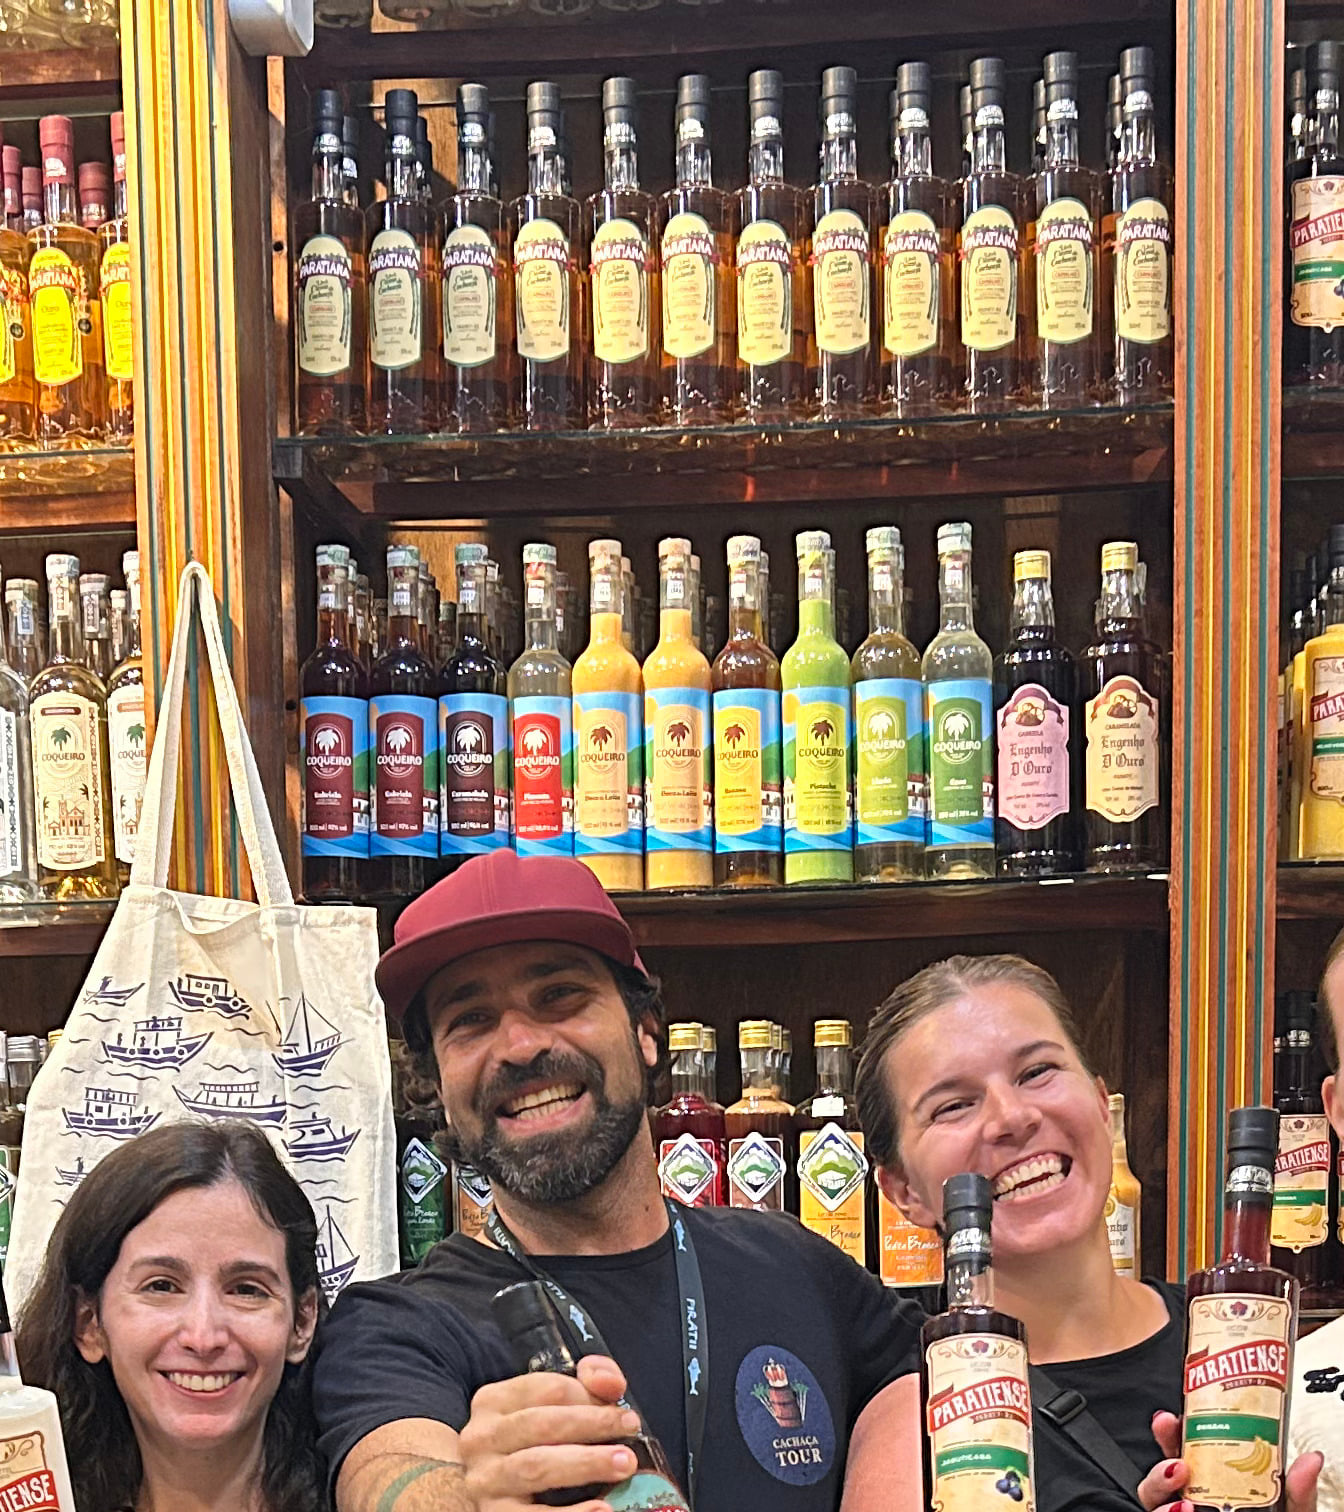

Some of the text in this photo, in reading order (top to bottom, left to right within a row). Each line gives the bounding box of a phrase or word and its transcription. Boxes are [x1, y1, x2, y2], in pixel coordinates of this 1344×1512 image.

[815, 238, 867, 255] PARATIANA
[886, 237, 939, 255] PARATIANA
[965, 229, 1017, 249] PARATIANA
[594, 244, 645, 261] PARATIANA
[370, 254, 418, 271] PARATIANA
[444, 252, 494, 269] PARATIANA
[299, 259, 349, 279] PARATIANA
[933, 740, 982, 752] COQUEIRO
[1009, 742, 1053, 757] Engenho
[1100, 734, 1145, 750] Engenho
[42, 751, 85, 762] COQUEIRO
[447, 753, 493, 765] COQUEIRO
[581, 752, 626, 762] COQUEIRO
[656, 747, 702, 758] COQUEIRO
[798, 748, 845, 758] COQUEIRO
[306, 755, 352, 767] COQUEIRO
[377, 754, 423, 767] COQUEIRO
[514, 755, 560, 767] COQUEIRO
[1189, 1345, 1286, 1390] PARATIENSE
[934, 1381, 1028, 1427] PARATIENSE
[773, 1436, 819, 1448] CACHAÇA
[776, 1449, 822, 1466] TOUR
